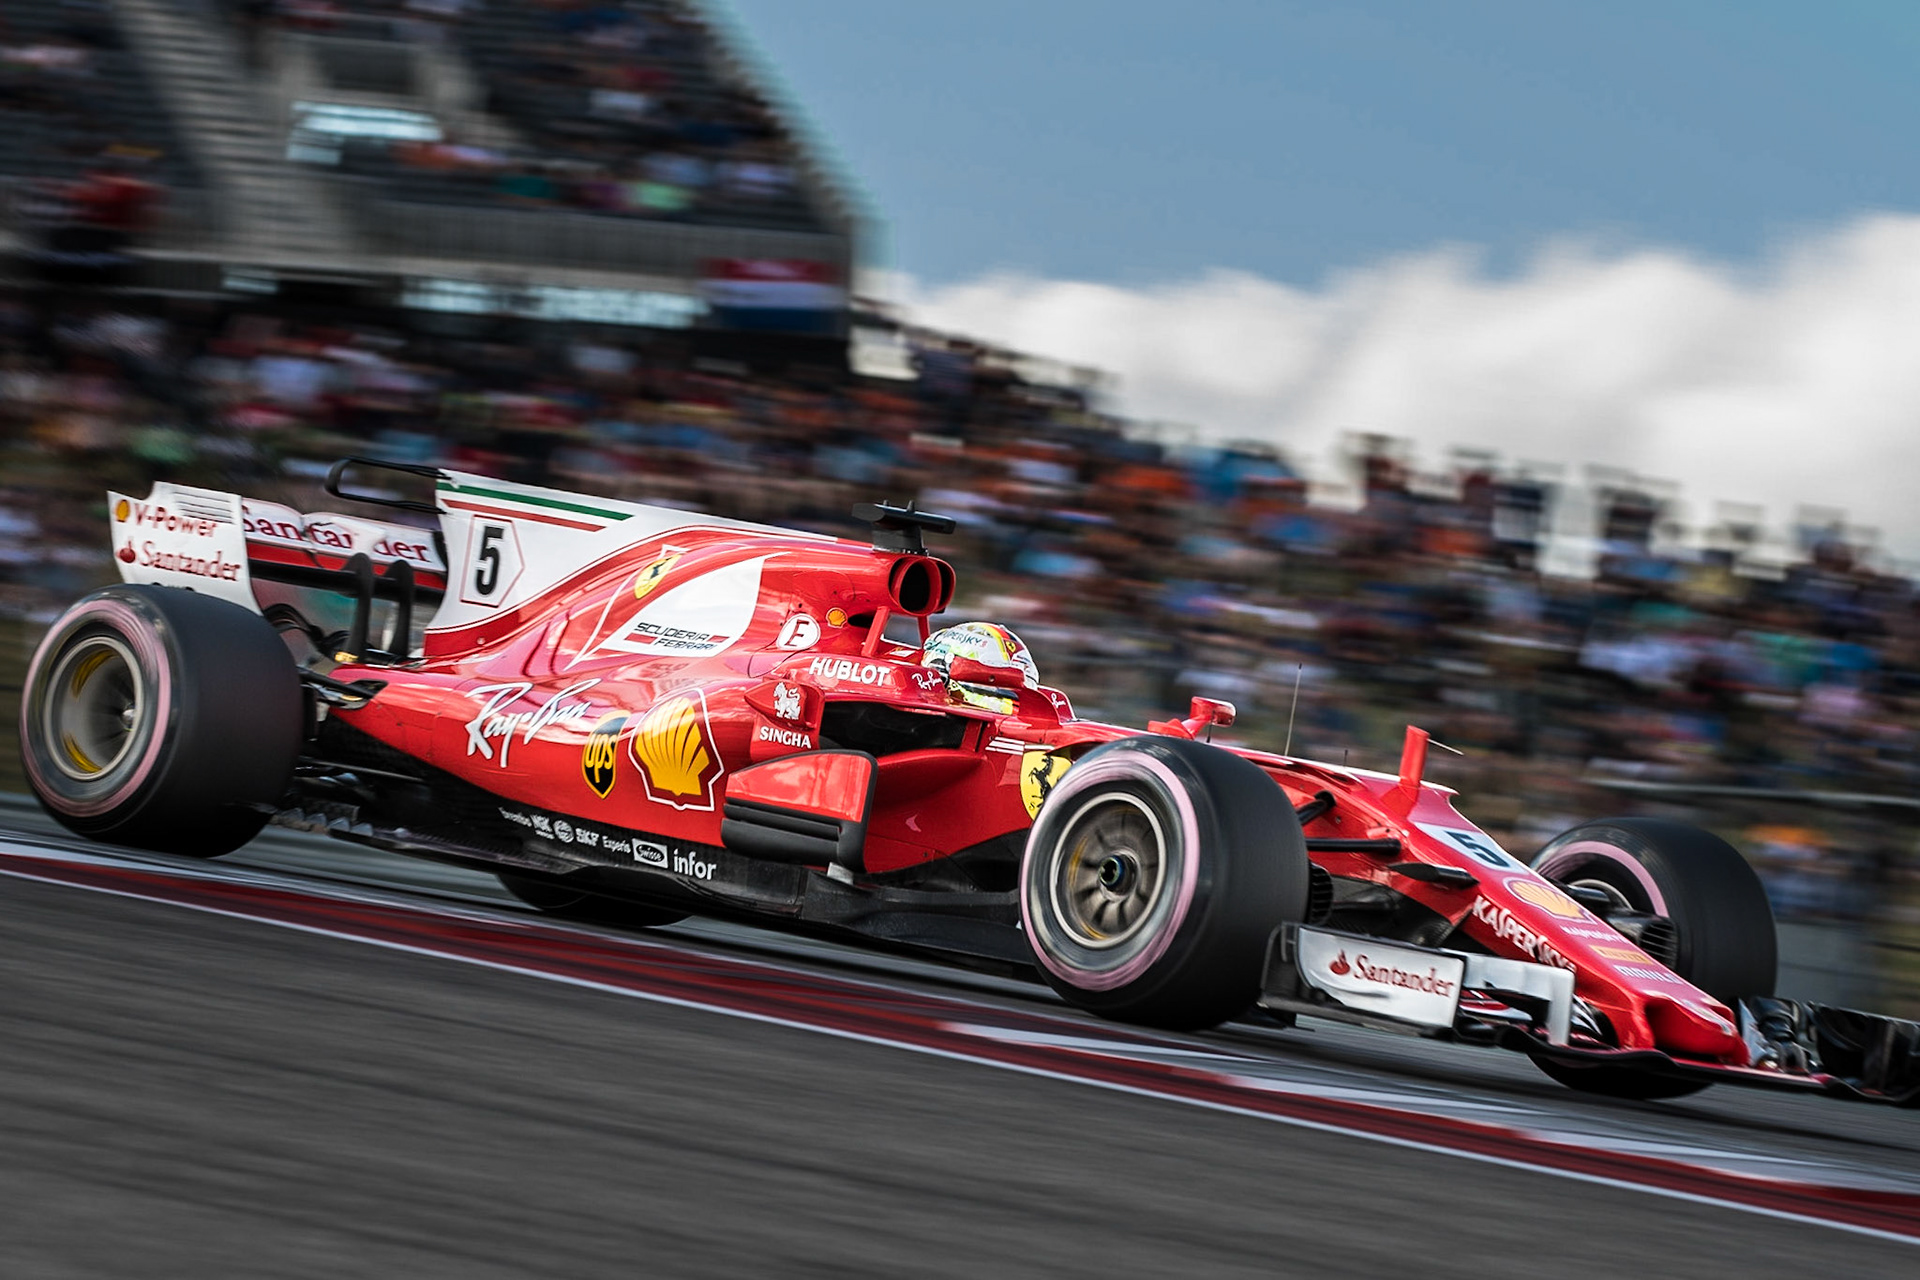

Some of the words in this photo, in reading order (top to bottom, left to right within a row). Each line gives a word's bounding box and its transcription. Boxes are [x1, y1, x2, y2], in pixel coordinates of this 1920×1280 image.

[134, 503, 217, 537] V-Power
[140, 540, 241, 581] Santander
[475, 525, 505, 595] 5
[634, 621, 710, 642] SCUDERIA
[654, 638, 718, 651] FERRARI
[808, 656, 891, 686] HUBLOT
[759, 725, 812, 749] SINGHA
[673, 849, 717, 880] infor
[1443, 830, 1510, 867] 5
[1354, 954, 1454, 997] Santander
